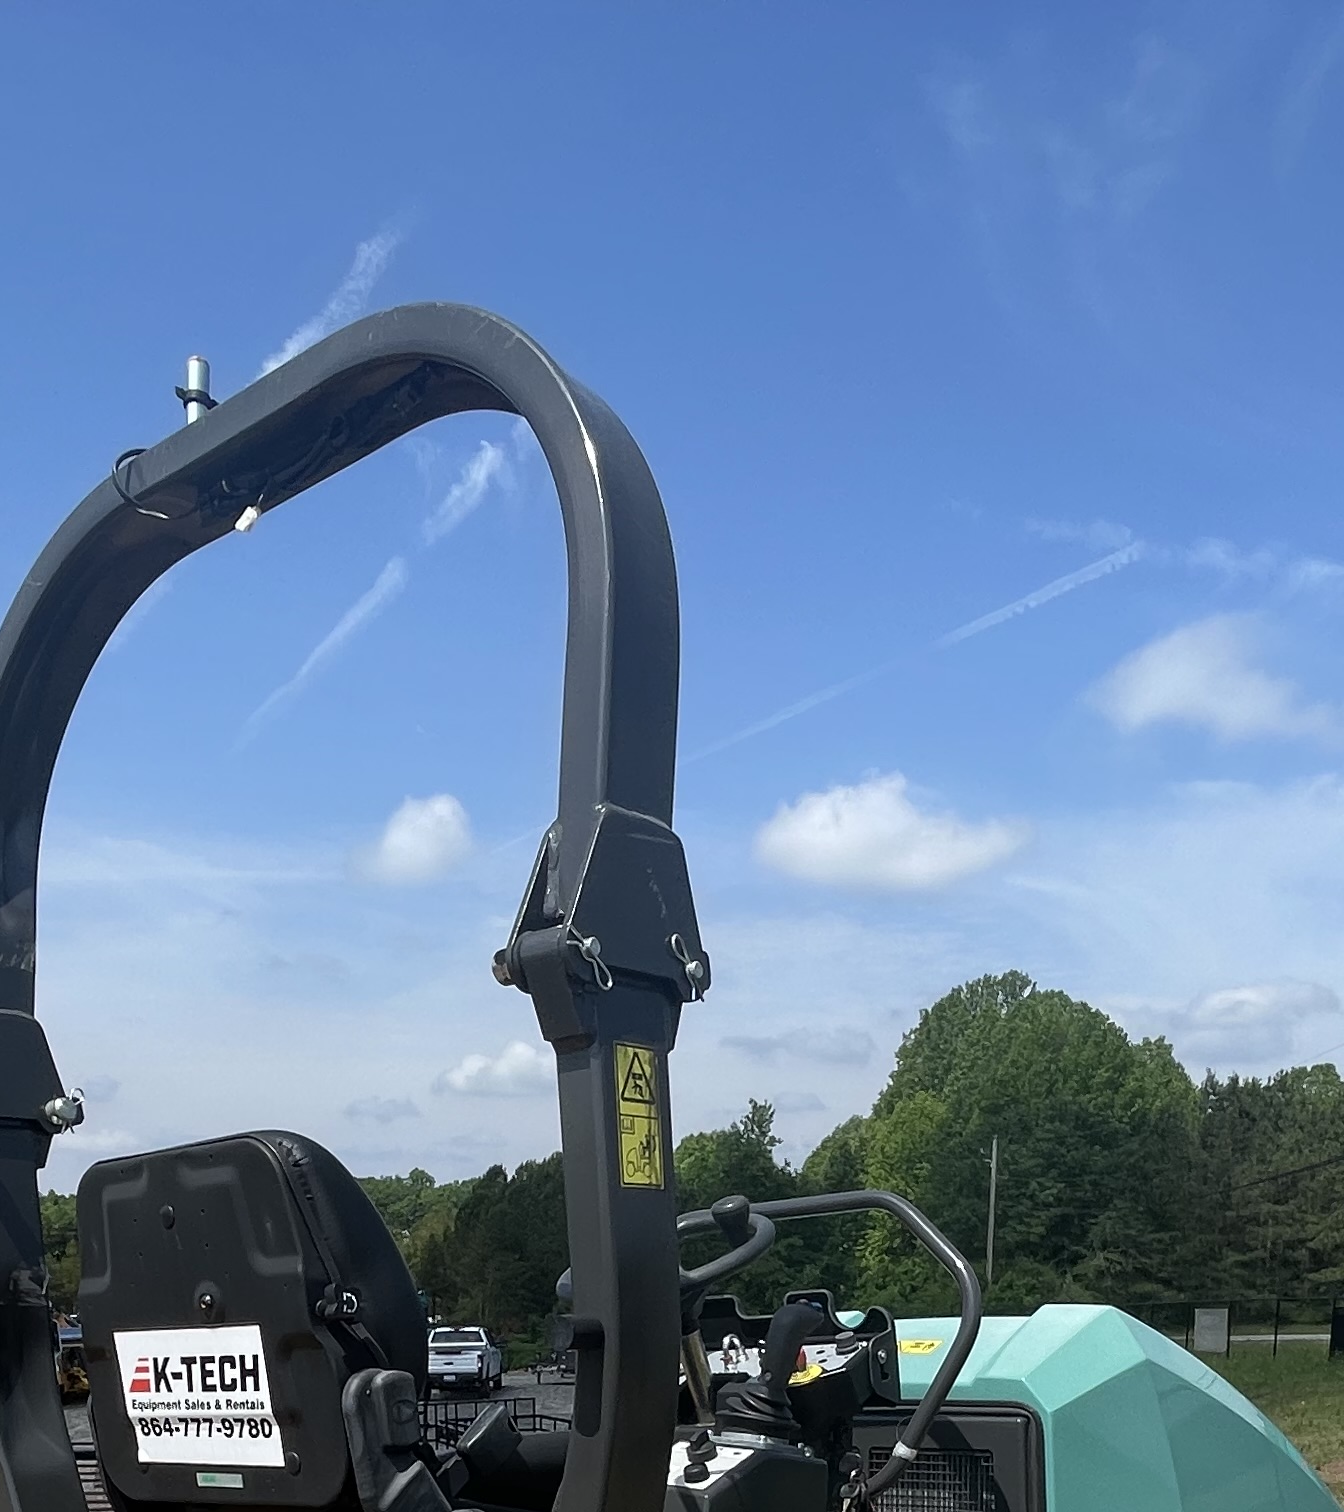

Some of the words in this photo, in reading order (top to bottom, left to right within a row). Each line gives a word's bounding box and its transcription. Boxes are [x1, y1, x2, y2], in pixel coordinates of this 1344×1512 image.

[152, 1354, 261, 1393] K-TECH
[132, 1400, 182, 1412] Equipment
[184, 1400, 212, 1410] Sales
[214, 1400, 222, 1410] &
[225, 1399, 265, 1410] Rentals
[138, 1417, 273, 1439] 864-777-9780
